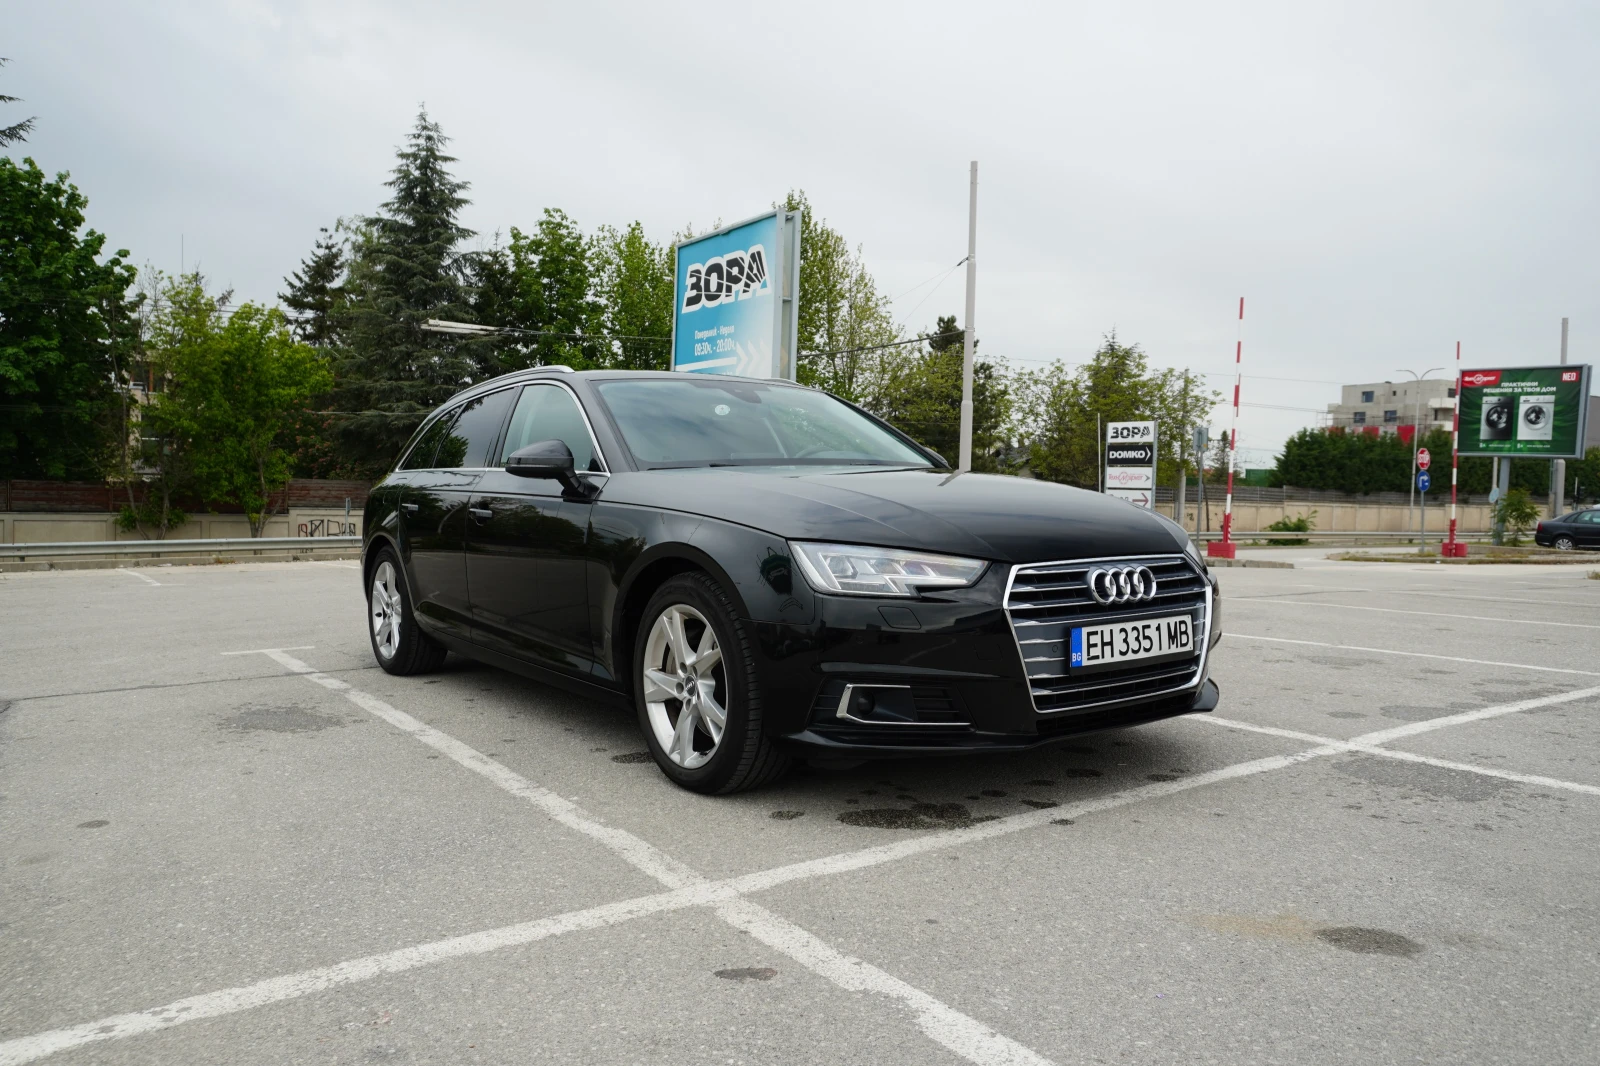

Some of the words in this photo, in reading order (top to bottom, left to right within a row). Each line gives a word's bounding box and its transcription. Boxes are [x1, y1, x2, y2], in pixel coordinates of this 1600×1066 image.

[684, 248, 769, 309] ЗОРА
[719, 325, 735, 337] Неделя
[1562, 372, 1577, 381] NEO
[1110, 426, 1151, 439] ЗОРА
[1108, 450, 1146, 459] DOMKO
[1418, 453, 1430, 463] STOP
[1071, 652, 1082, 662] BG
